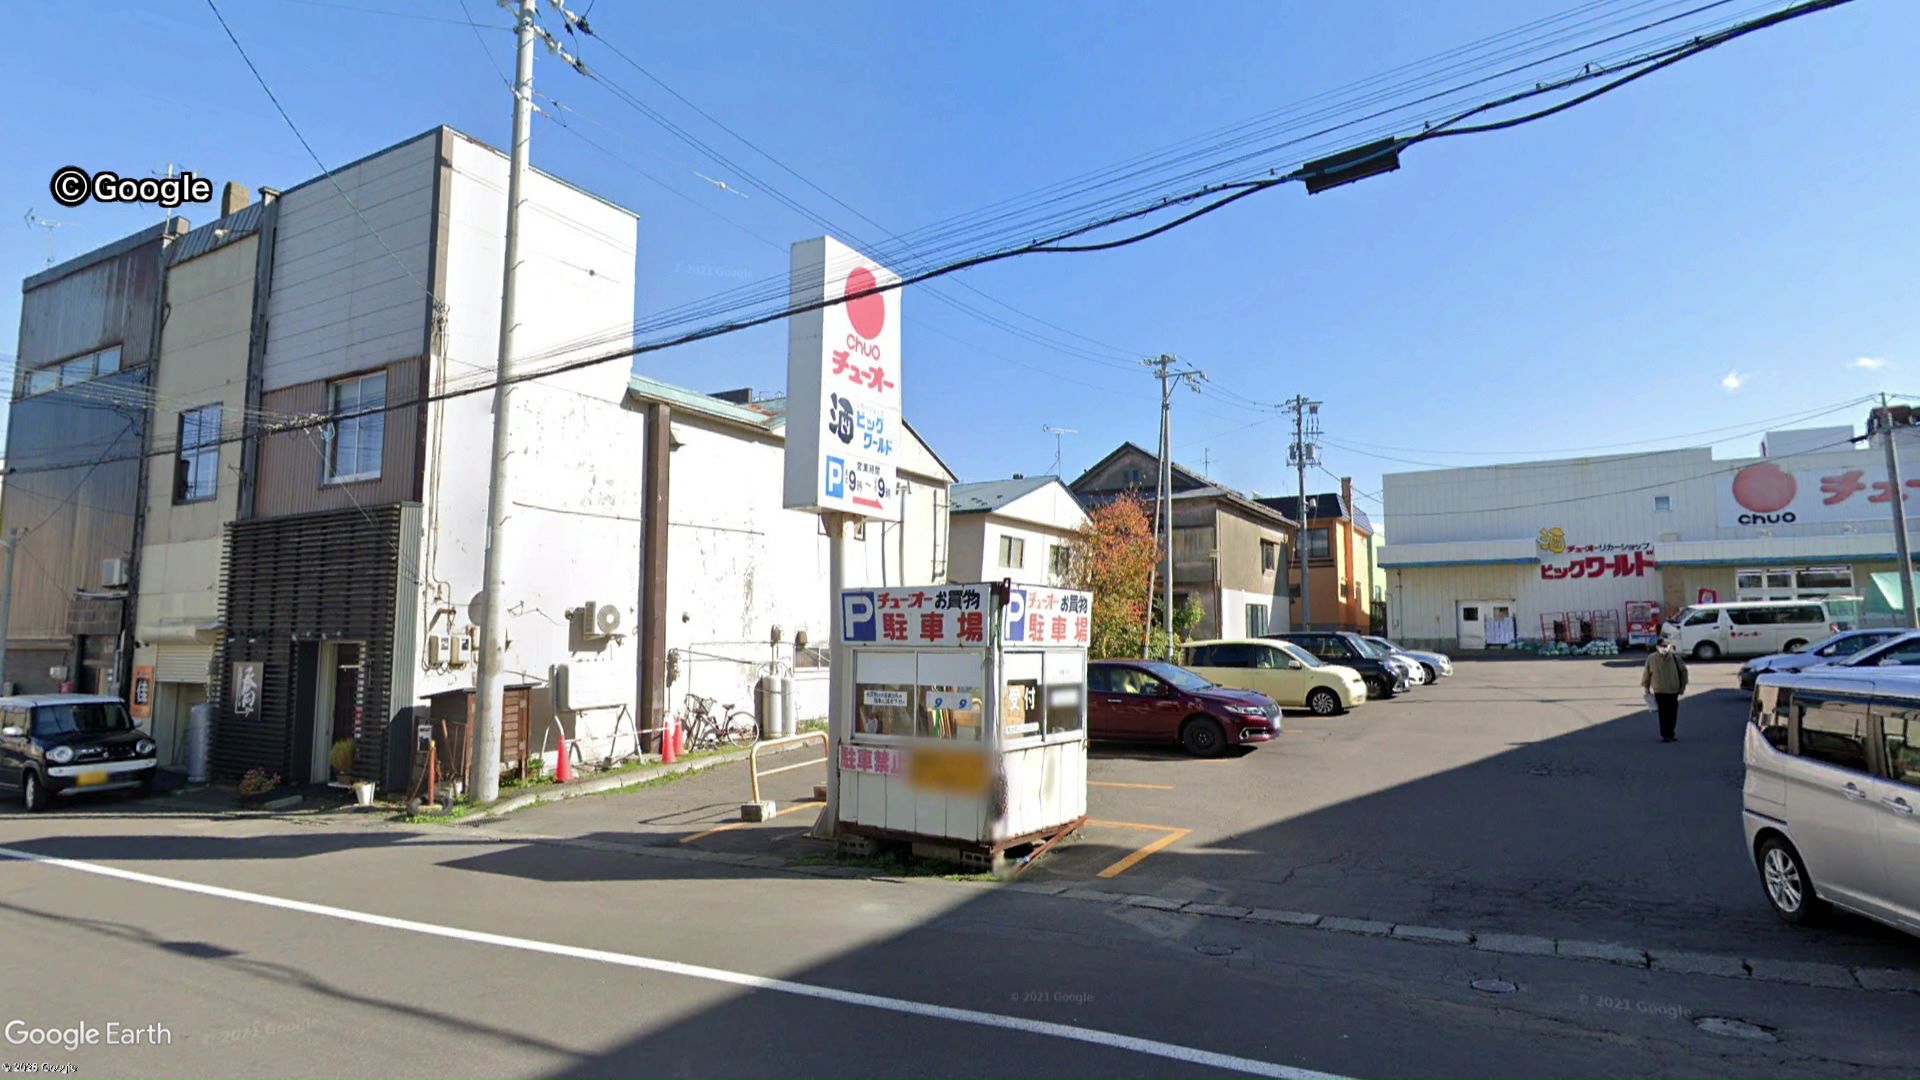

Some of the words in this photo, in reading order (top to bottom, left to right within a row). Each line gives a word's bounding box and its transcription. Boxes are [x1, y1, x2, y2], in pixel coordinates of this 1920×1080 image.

[832, 349, 894, 393] チューオー
[829, 392, 854, 444] 酒
[863, 432, 893, 456] ワールド
[828, 460, 843, 493] P
[844, 595, 874, 639] P
[883, 612, 983, 642] 駐車場
[1005, 591, 1025, 640] P
[1029, 613, 1088, 642] 駐車場
